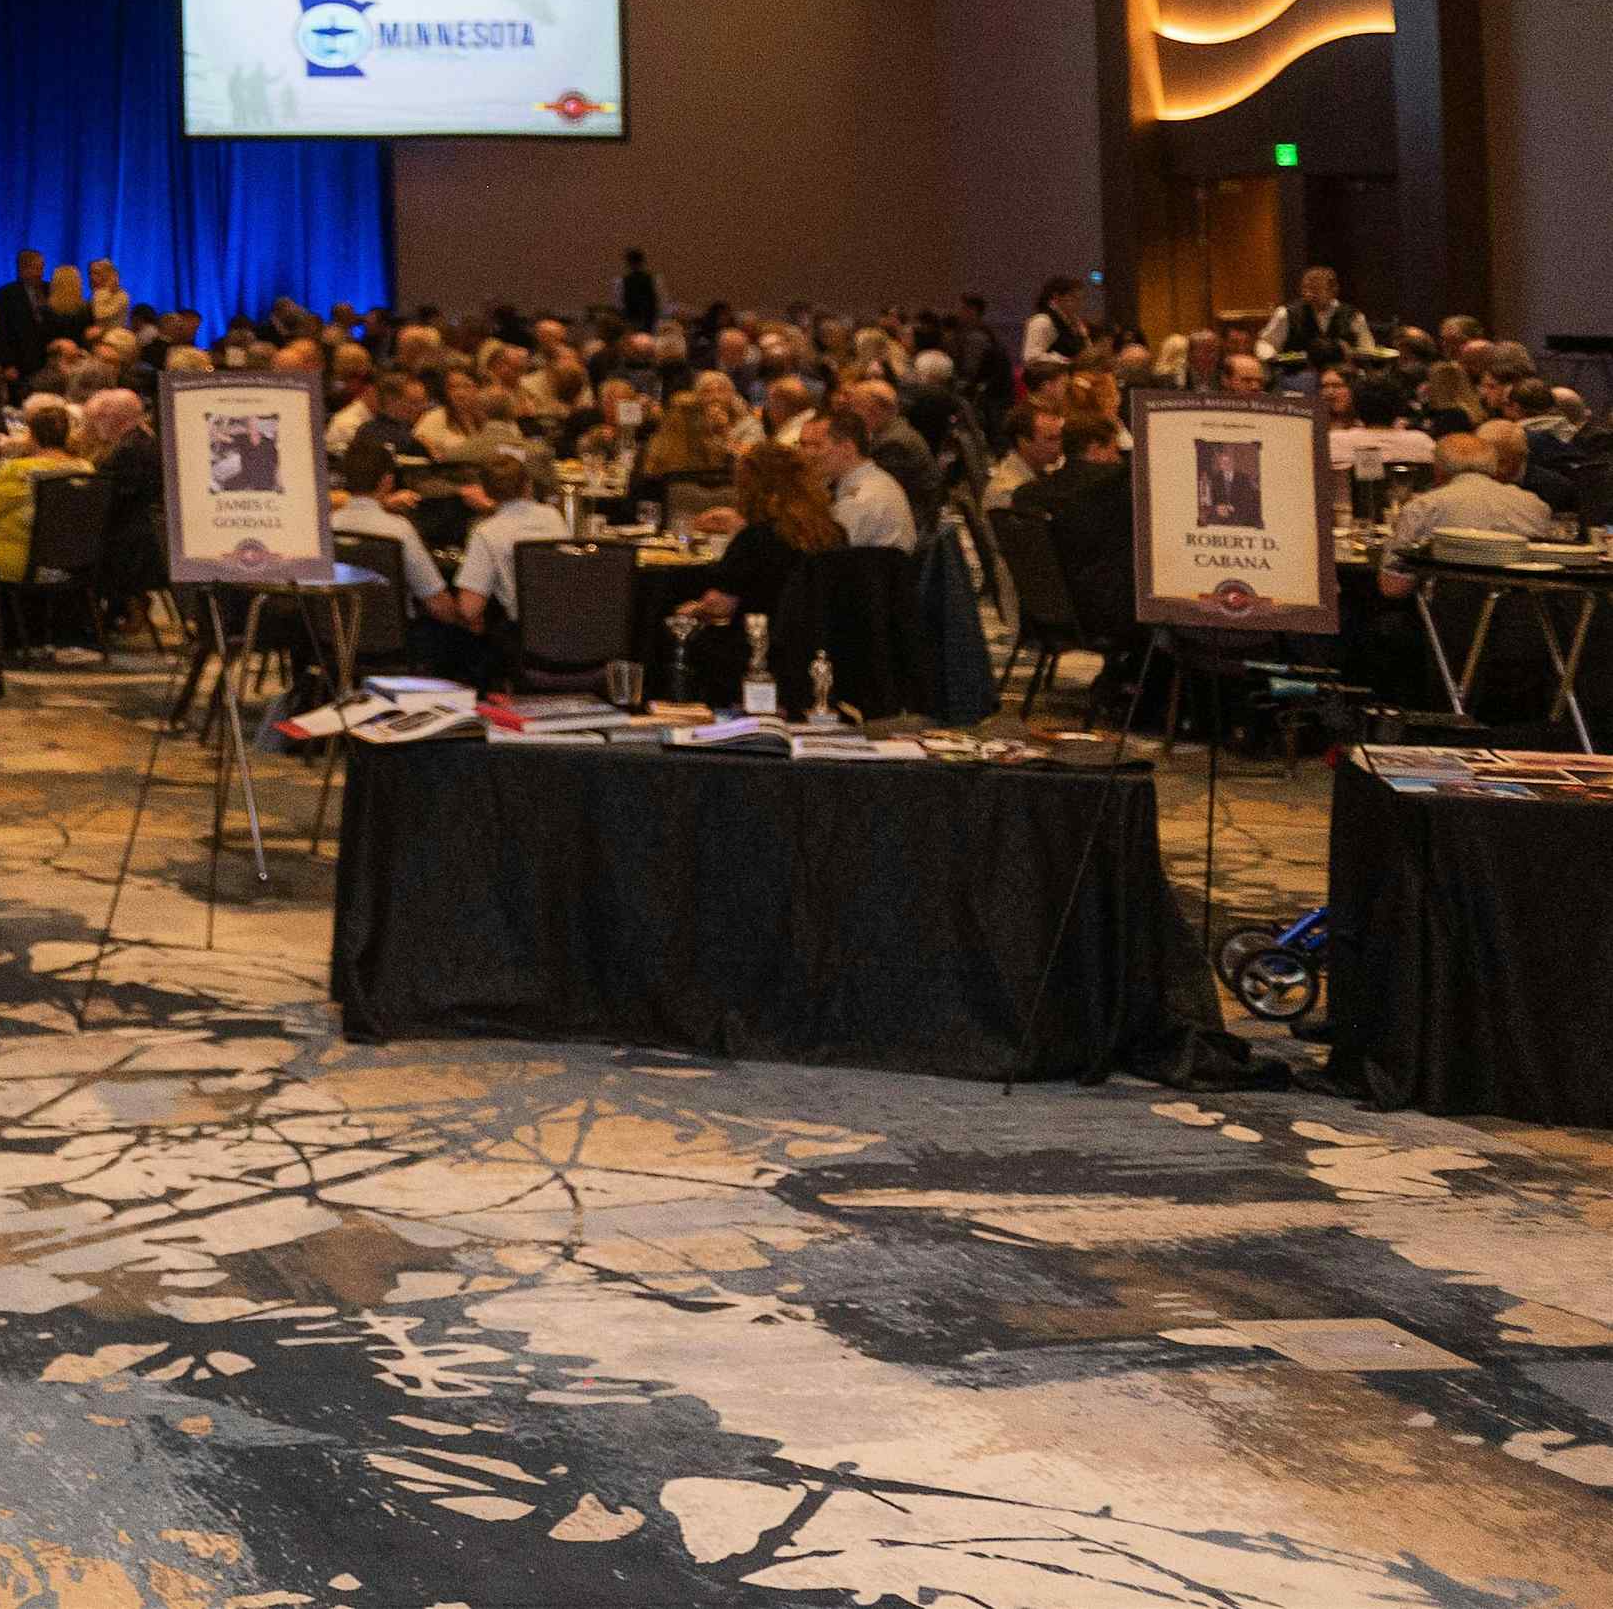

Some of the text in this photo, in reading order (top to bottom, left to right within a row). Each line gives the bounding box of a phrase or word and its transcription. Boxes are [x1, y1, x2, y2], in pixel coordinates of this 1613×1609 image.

[379, 21, 535, 47] MINNESOTA
[1185, 532, 1280, 551] ROBERT D.
[1193, 553, 1272, 570] CABANA
